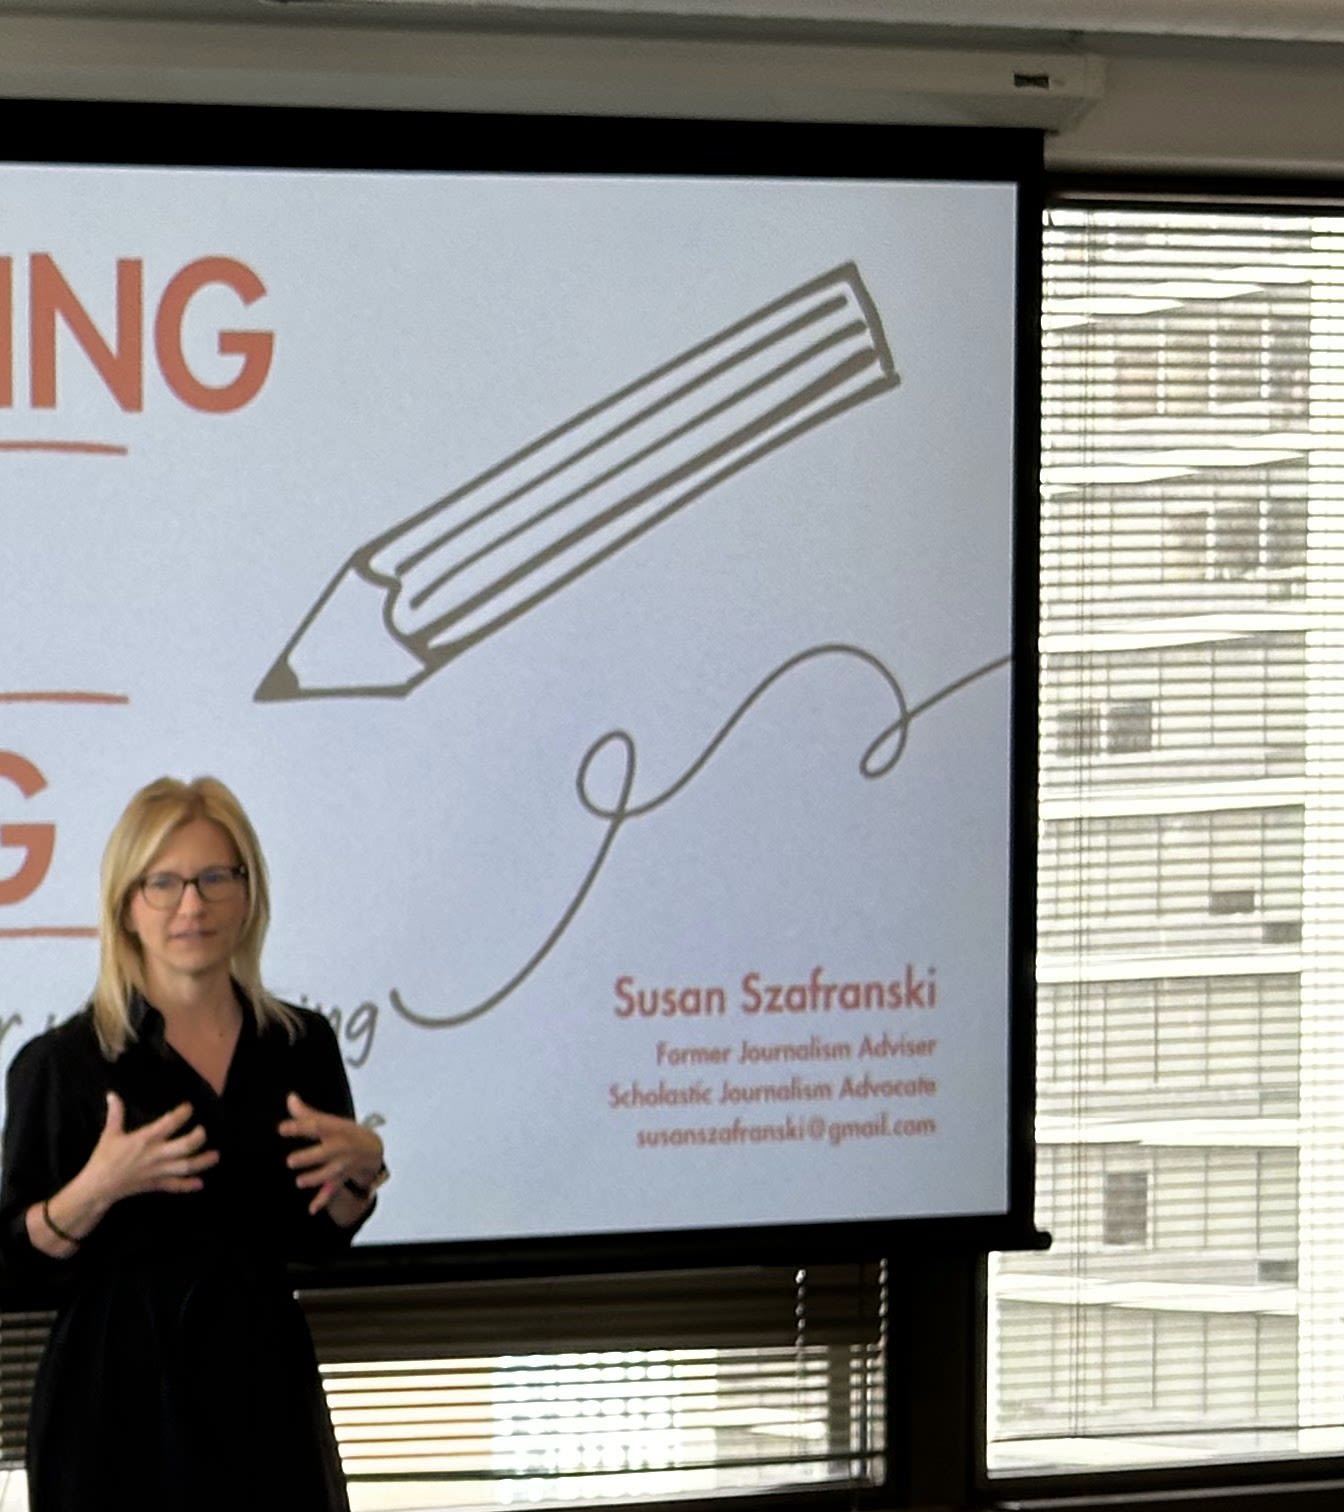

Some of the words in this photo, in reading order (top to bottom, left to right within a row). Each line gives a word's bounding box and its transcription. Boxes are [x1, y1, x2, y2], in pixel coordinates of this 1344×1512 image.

[613, 976, 726, 1019] Susan
[741, 964, 938, 1014] Szafranski
[656, 1039, 732, 1066] Former
[739, 1035, 851, 1064] Journalism
[858, 1031, 938, 1058] Adviser
[609, 1081, 712, 1109] Scholastic
[719, 1076, 833, 1104] Journalism
[839, 1073, 938, 1099] Advocate
[636, 1112, 938, 1147] susanszafranski@gmail.com
